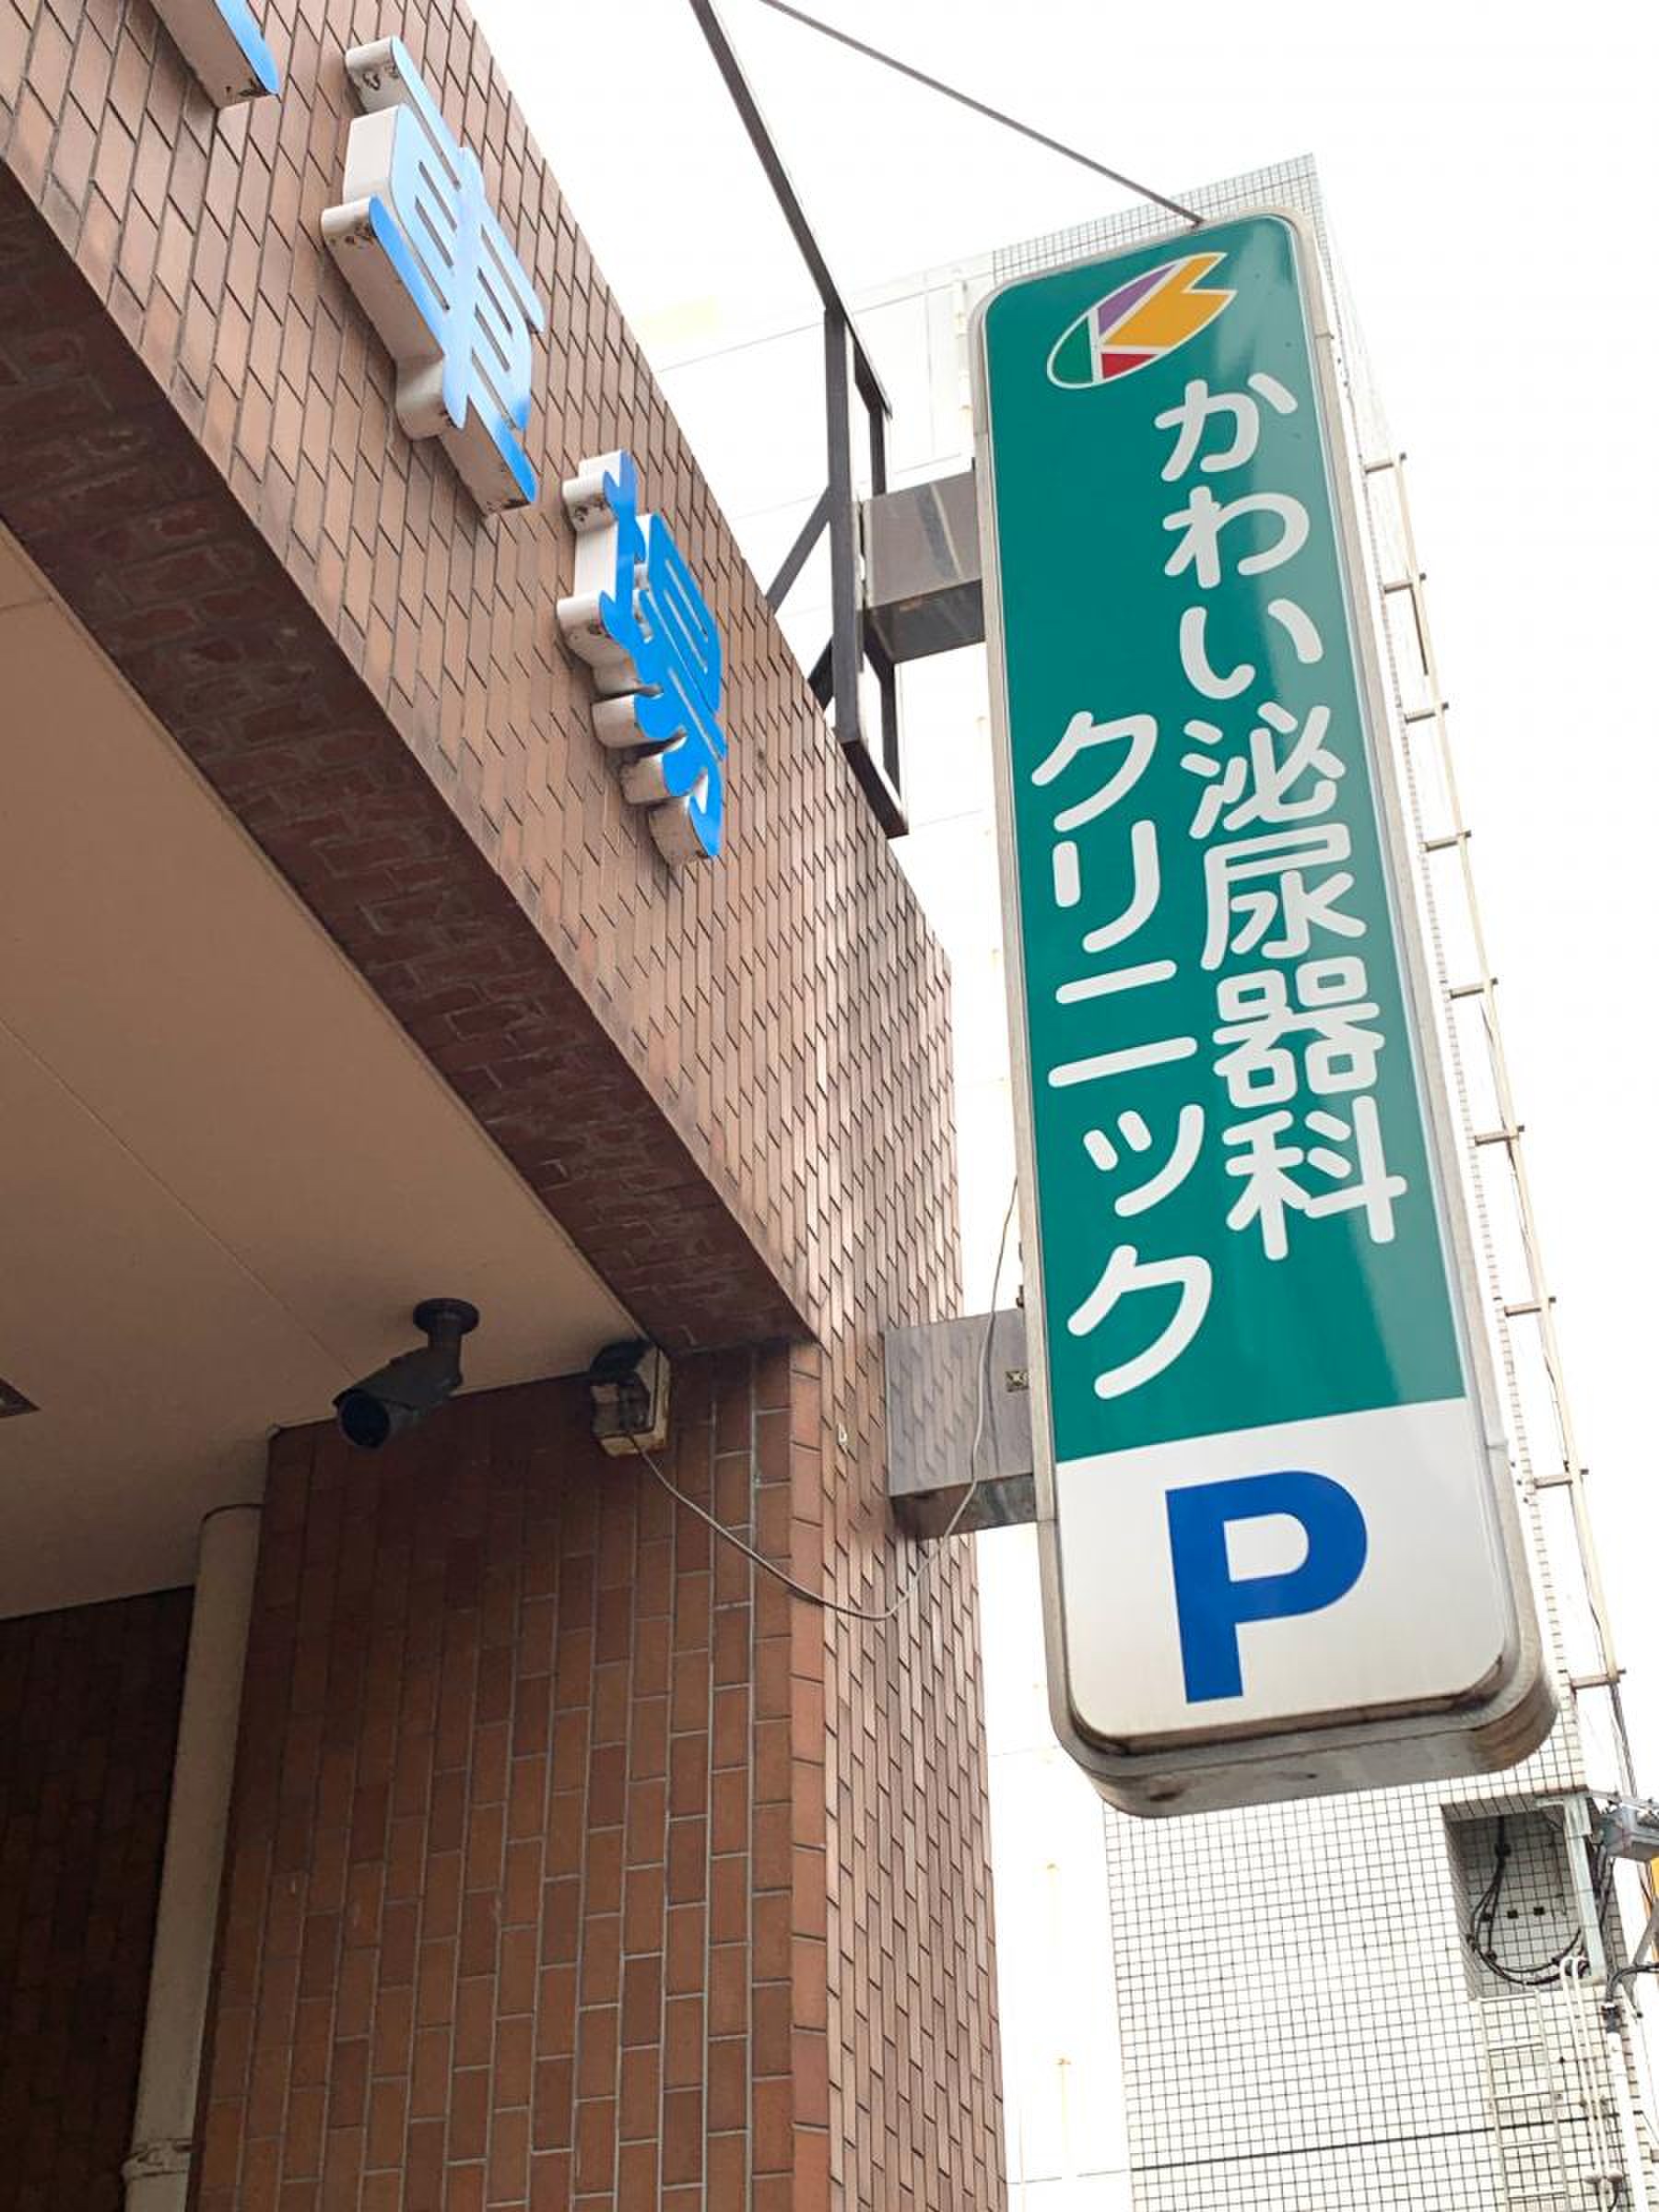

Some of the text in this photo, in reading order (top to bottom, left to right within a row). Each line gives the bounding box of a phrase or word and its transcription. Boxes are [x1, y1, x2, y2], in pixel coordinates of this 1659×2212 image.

[217, 0, 729, 859] 車場
[1154, 371, 1408, 1262] かわい泌尿器科
[1030, 711, 1214, 1400] クリニック
[1165, 1470, 1369, 1704] P
